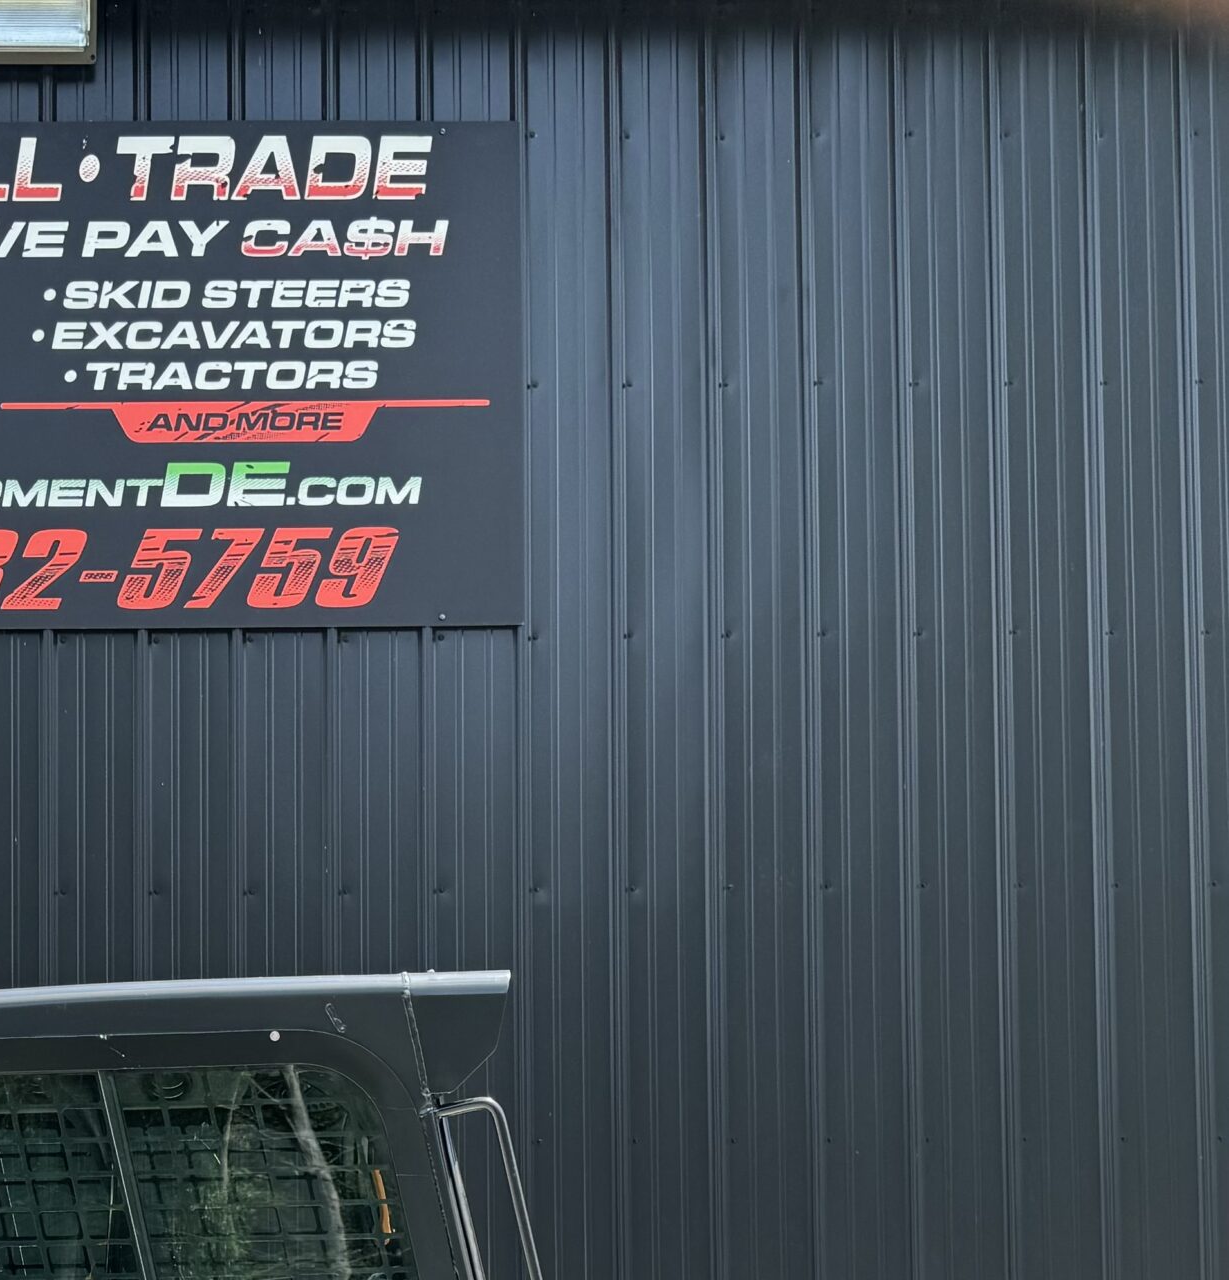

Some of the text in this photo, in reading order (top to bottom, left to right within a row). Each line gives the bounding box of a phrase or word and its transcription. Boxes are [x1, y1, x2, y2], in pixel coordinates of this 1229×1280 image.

[116, 134, 433, 201] TRADE
[81, 220, 229, 258] PAY
[240, 216, 449, 261] CA$H
[63, 279, 411, 309] SKID STEERS
[51, 319, 417, 350] EXCAVATORS
[86, 361, 379, 391] TRACTORS
[145, 411, 344, 432] AND MORE
